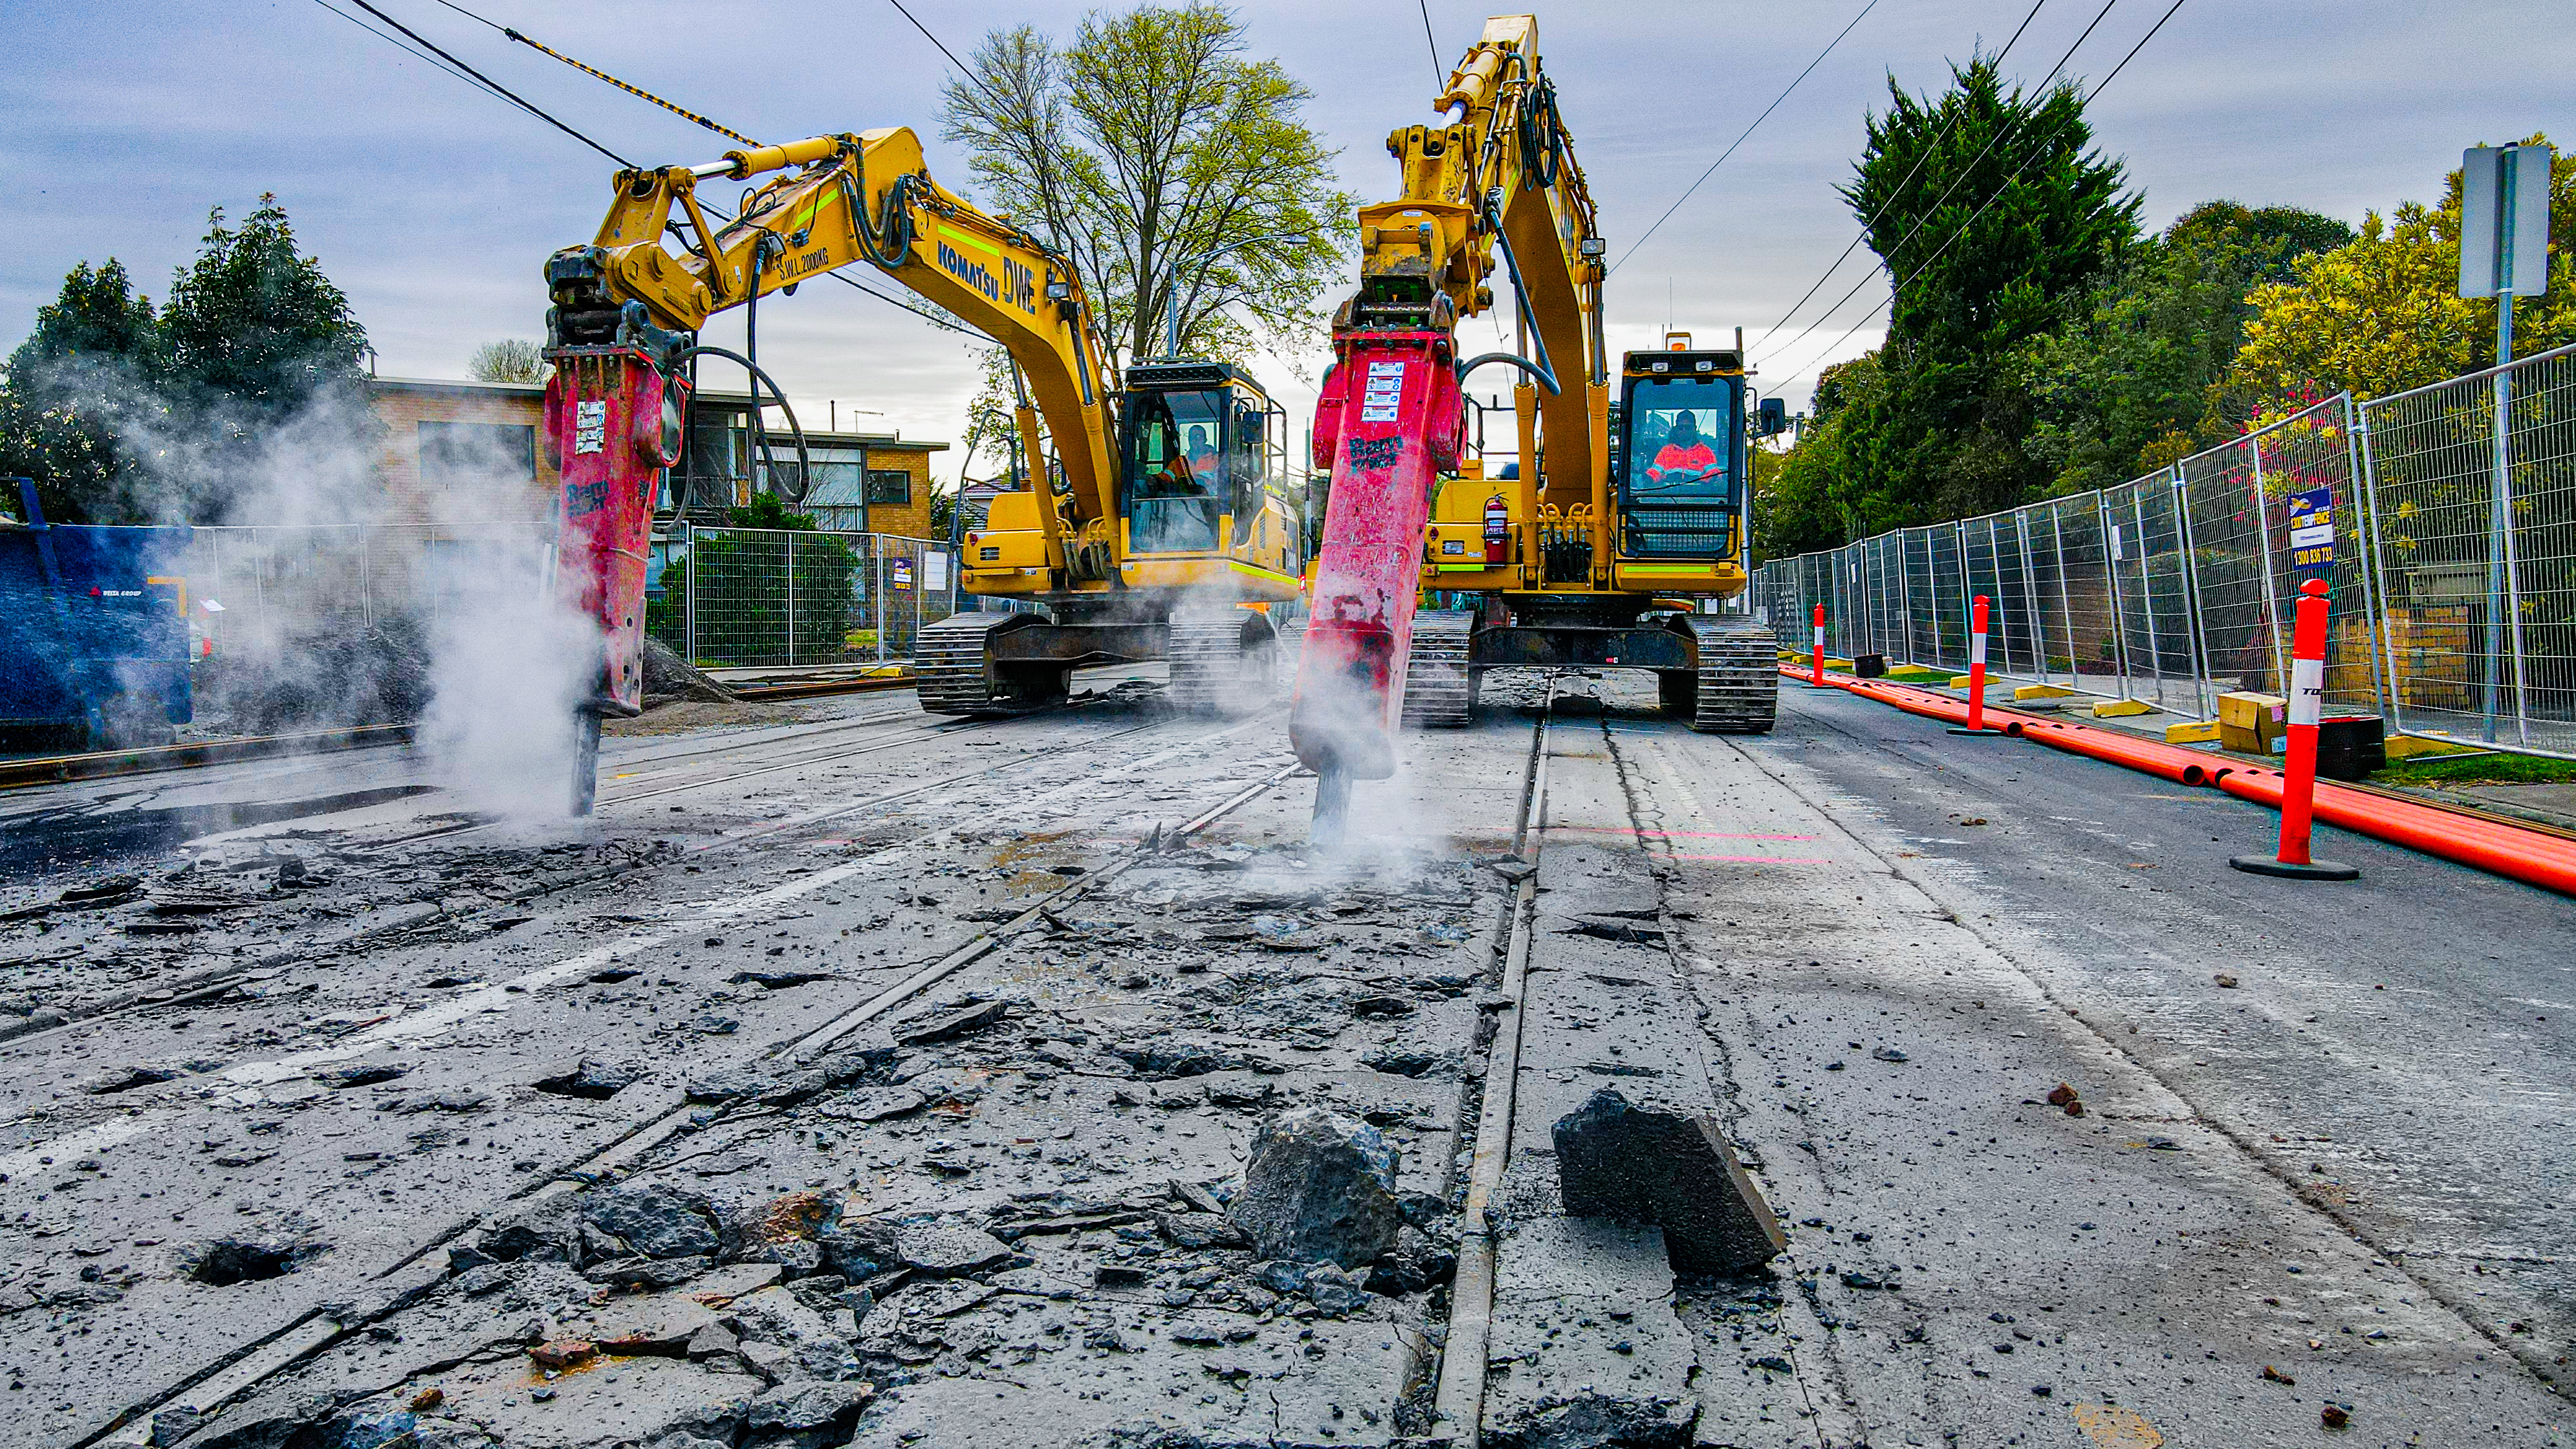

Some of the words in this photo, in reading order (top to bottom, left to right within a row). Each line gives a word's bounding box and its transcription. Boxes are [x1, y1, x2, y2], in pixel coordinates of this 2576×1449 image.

[938, 240, 998, 302] KOMATSU
[1003, 256, 1035, 315] DWE
[2294, 550, 2309, 566] 1300
